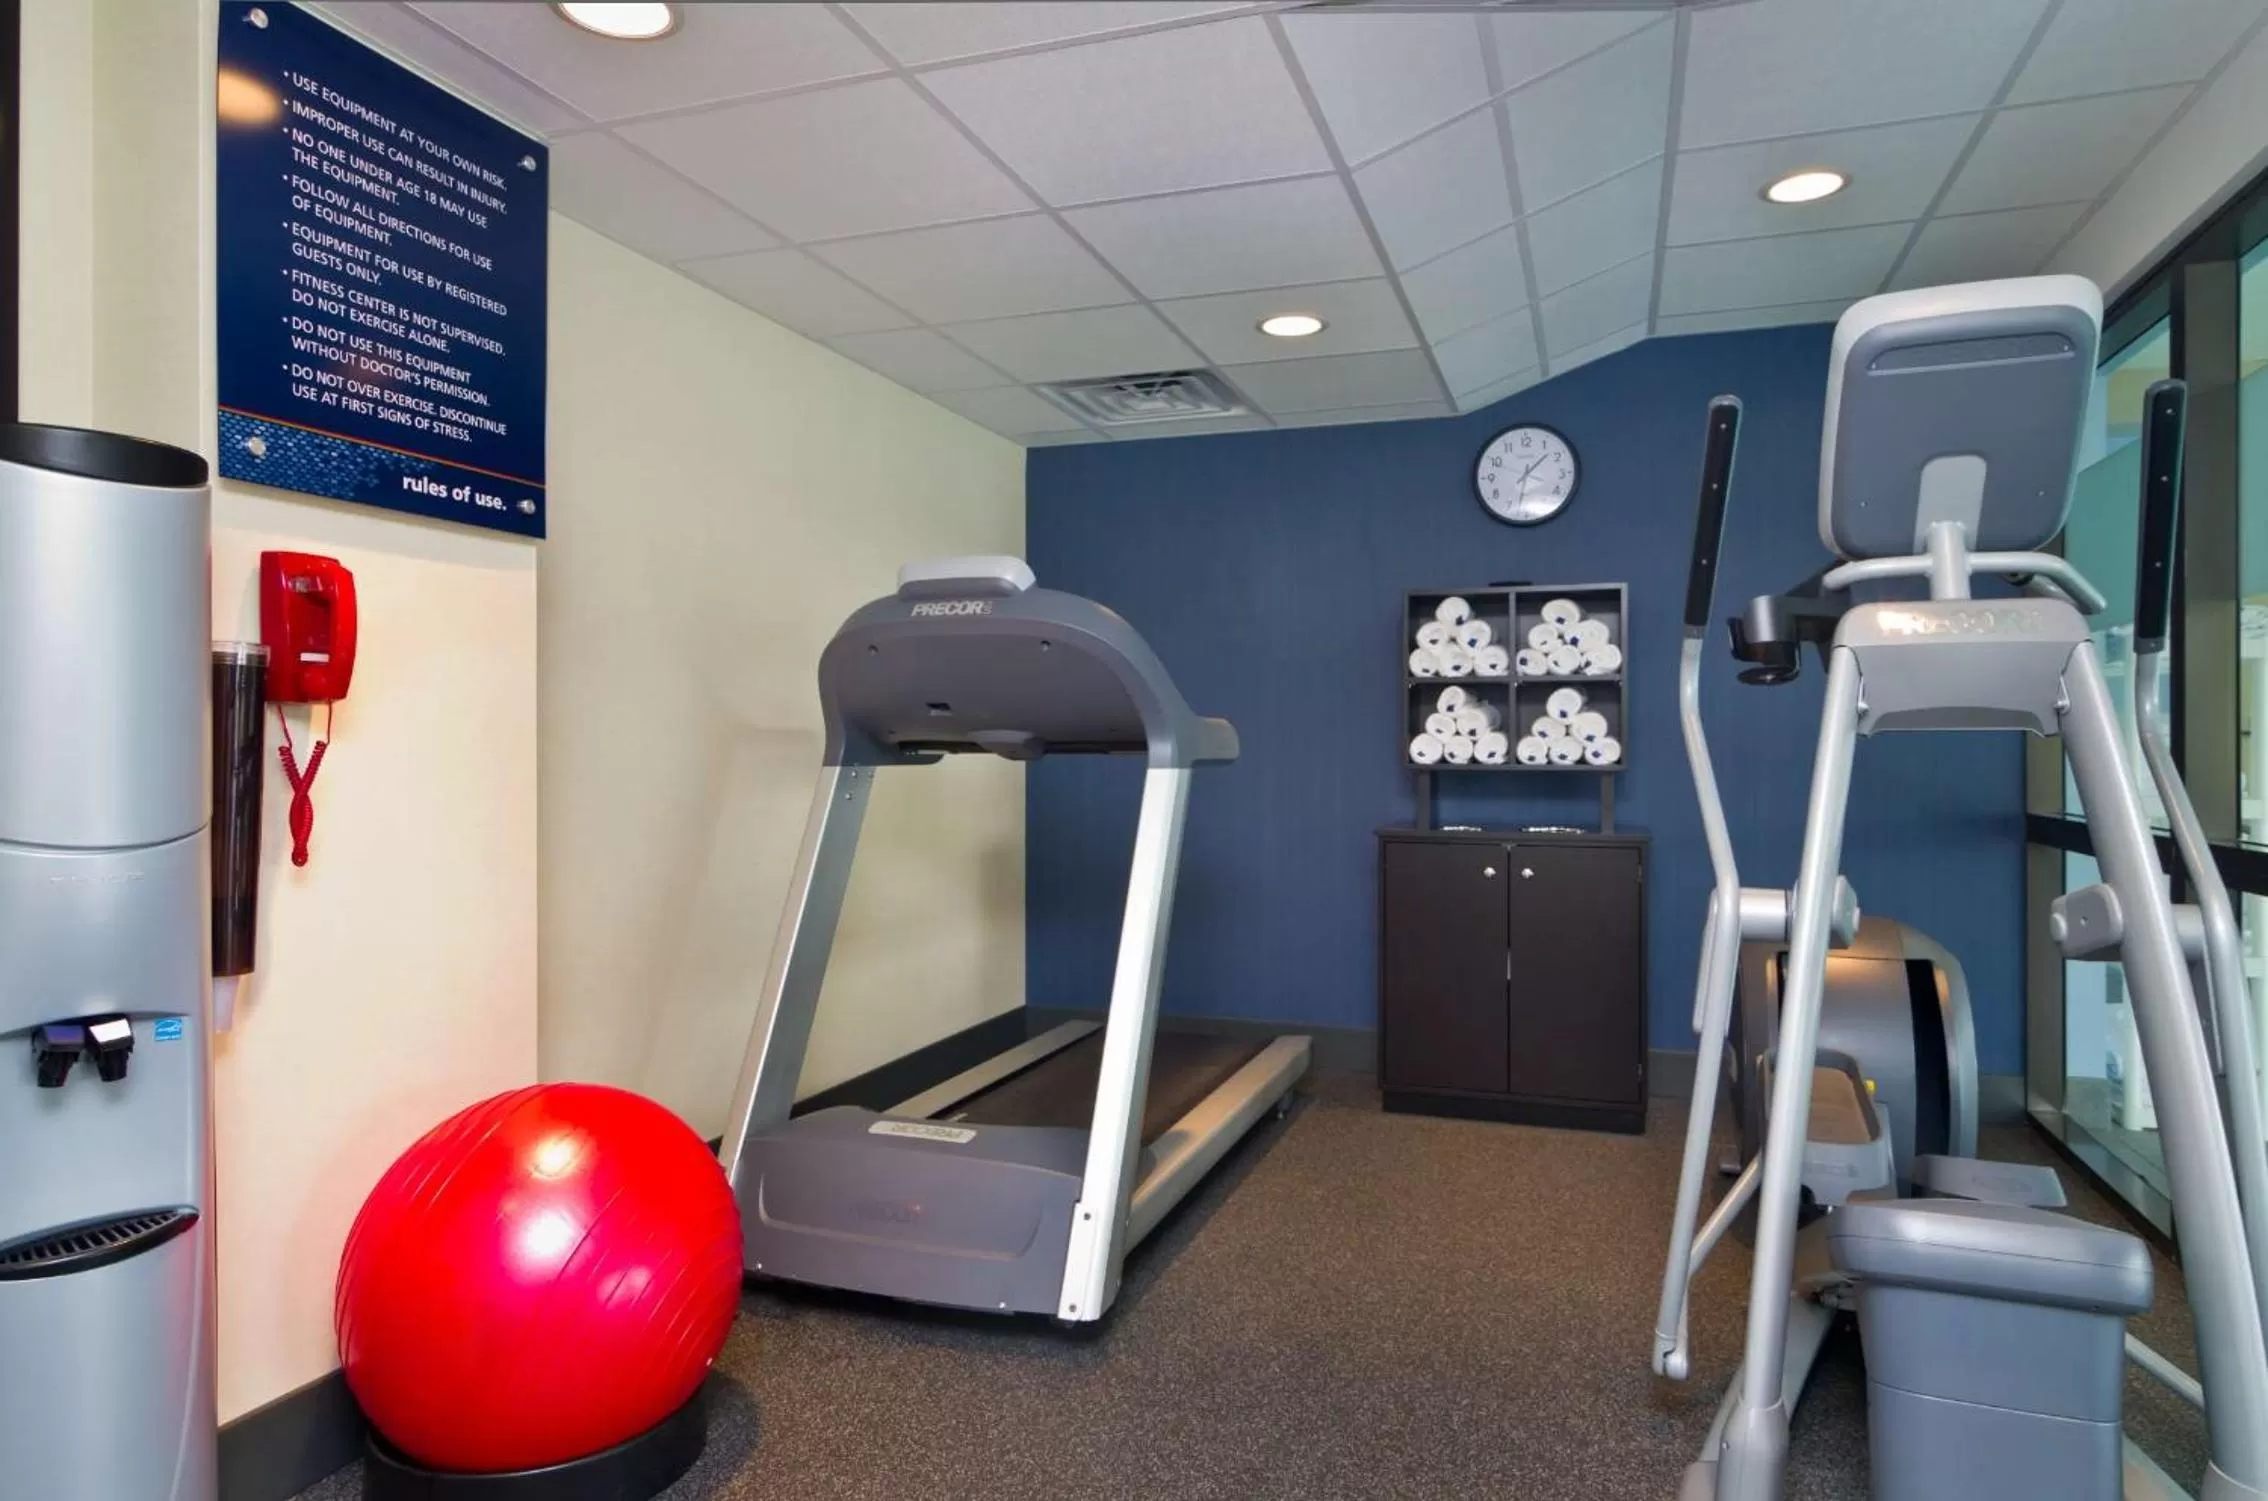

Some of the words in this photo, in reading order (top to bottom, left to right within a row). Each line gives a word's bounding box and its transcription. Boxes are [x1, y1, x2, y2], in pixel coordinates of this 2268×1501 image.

[292, 72, 319, 96] USE
[322, 87, 396, 134] EQUIPMENT
[399, 128, 415, 143] AT
[417, 136, 450, 162] YOUR
[452, 154, 480, 177] OWN
[292, 100, 359, 143] IMPROPER
[362, 134, 385, 155] USE
[387, 147, 413, 169] CAN
[416, 160, 455, 188] RESULT
[457, 181, 468, 195] IN
[291, 146, 319, 170] THE
[322, 161, 400, 206] EQUIPMENT.
[292, 128, 314, 148] NO
[317, 140, 346, 164] ONE
[350, 155, 393, 184] UNDER
[396, 177, 420, 198] AGE
[424, 190, 437, 205] 18
[440, 196, 465, 217] MAY
[467, 209, 488, 229] USE
[292, 195, 311, 211] OF
[315, 204, 392, 247] EQUIPMENT.
[292, 174, 350, 209] FOLLOW
[352, 202, 375, 221] ALL
[378, 212, 447, 251] DIRECTIONS
[449, 242, 470, 262] FOR
[472, 253, 493, 271] USE
[292, 242, 343, 271] GUESTS
[346, 262, 382, 286] ONLY.
[292, 222, 371, 263] EQUIPMENT
[375, 255, 399, 274] FOR
[402, 265, 424, 284] USE
[427, 275, 442, 291] BY
[445, 282, 507, 316] REGISTERED
[292, 269, 345, 298] FITNESS
[348, 289, 396, 317] CENTER
[399, 308, 409, 321] IS
[412, 312, 438, 331] NOT
[440, 322, 506, 357] SUPERVISED.
[292, 288, 314, 306] DO
[318, 297, 347, 317] NOT
[350, 308, 406, 338] EXERCISE
[291, 335, 357, 366] WITHOUT
[360, 356, 421, 386] DOCTOR'S
[292, 316, 314, 334] DO
[317, 324, 347, 344] NOT
[350, 334, 373, 353] USE
[376, 342, 403, 362] THIS
[405, 352, 472, 383] EQUIPMENT
[291, 363, 313, 380] DO
[316, 370, 344, 389] NOT
[347, 380, 381, 400] OVER
[440, 406, 507, 436] DISCONTINUE
[292, 382, 318, 401] USE
[321, 391, 338, 406] AT
[342, 396, 375, 416] FIRST
[377, 406, 412, 426] SIGNS
[415, 416, 430, 430] OF
[433, 421, 473, 443] STRESS.
[1520, 436, 1532, 448] 12
[402, 476, 448, 498] rules
[451, 486, 472, 503] of
[475, 492, 508, 511] use.
[911, 600, 984, 617] PRECOR
